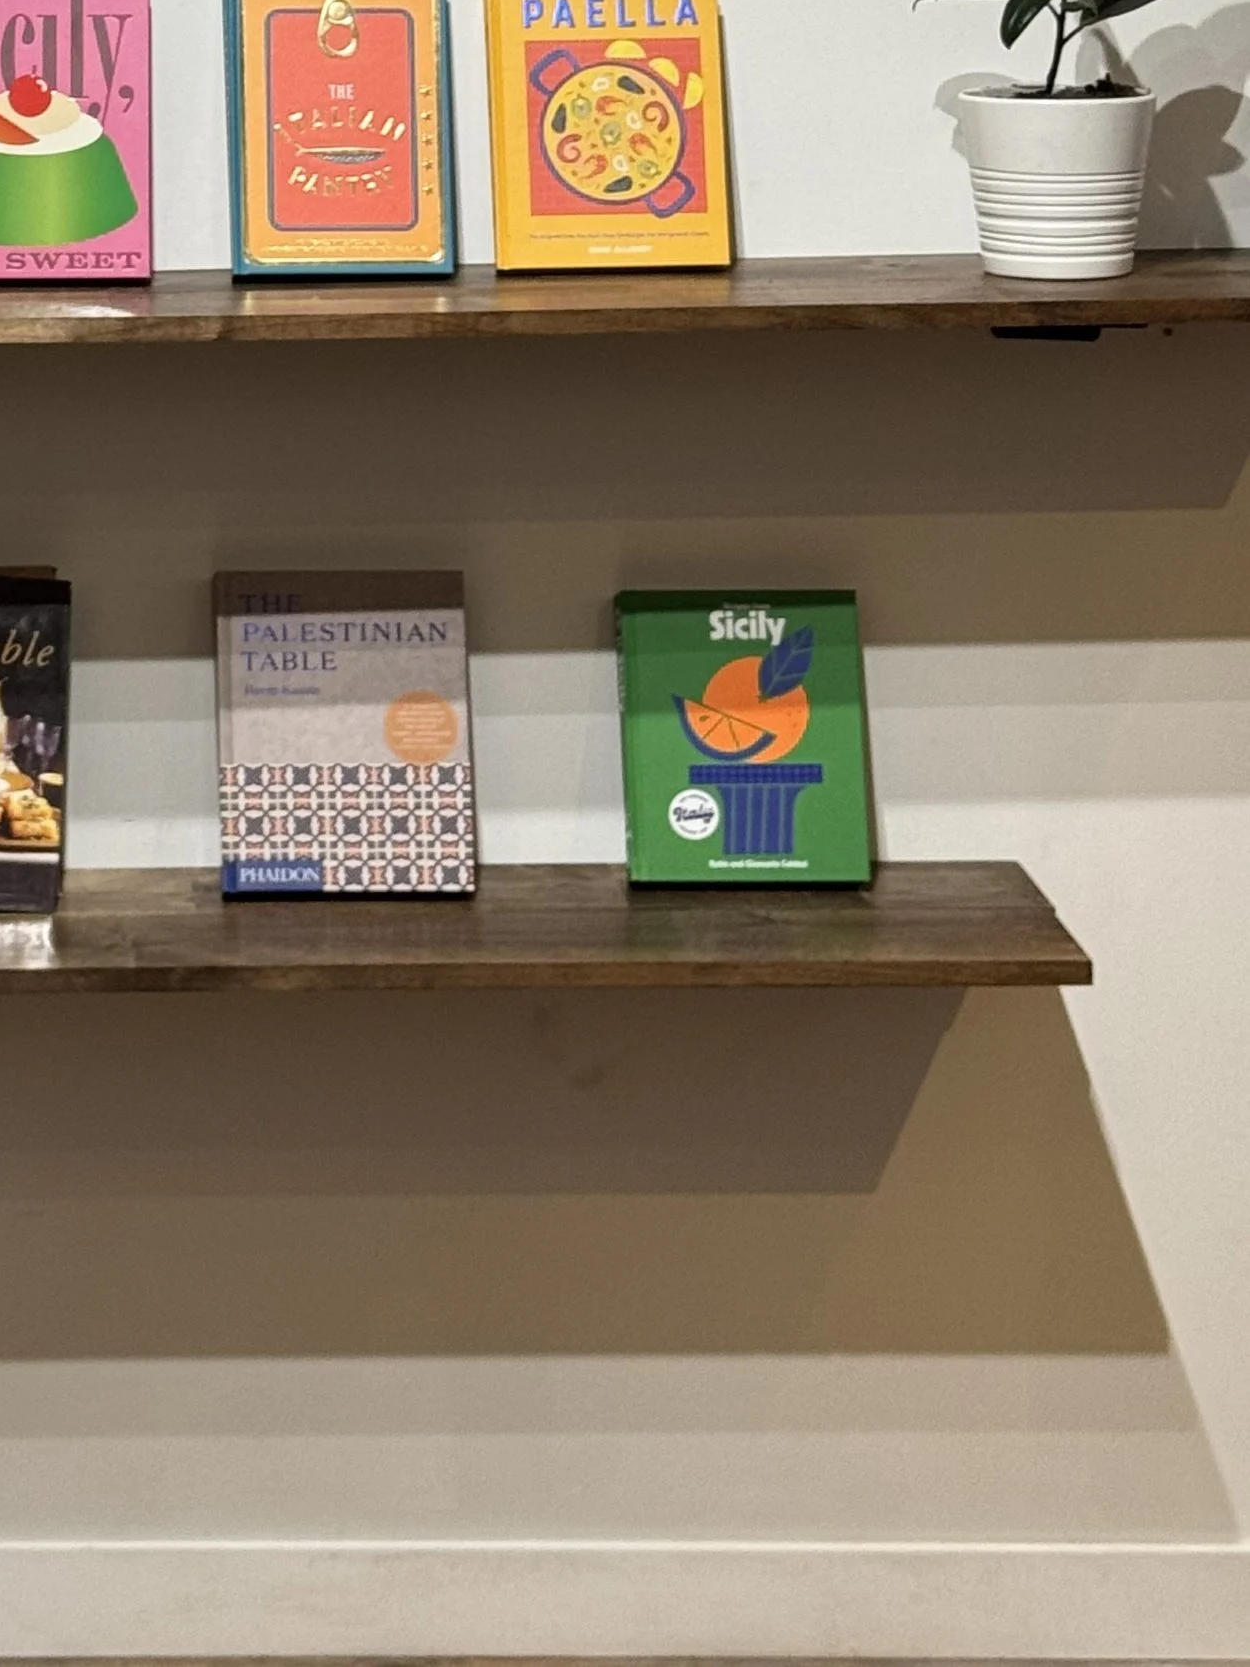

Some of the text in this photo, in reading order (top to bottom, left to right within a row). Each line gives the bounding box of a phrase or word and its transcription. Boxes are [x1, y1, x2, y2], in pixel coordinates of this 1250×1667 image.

[328, 83, 355, 100] THE
[6, 253, 142, 270] SWEET
[239, 594, 301, 613] THE
[241, 621, 448, 643] PALESTINIAN
[709, 610, 786, 646] Sicily
[241, 651, 338, 672] TABLE
[240, 867, 320, 883] PHAIDON
